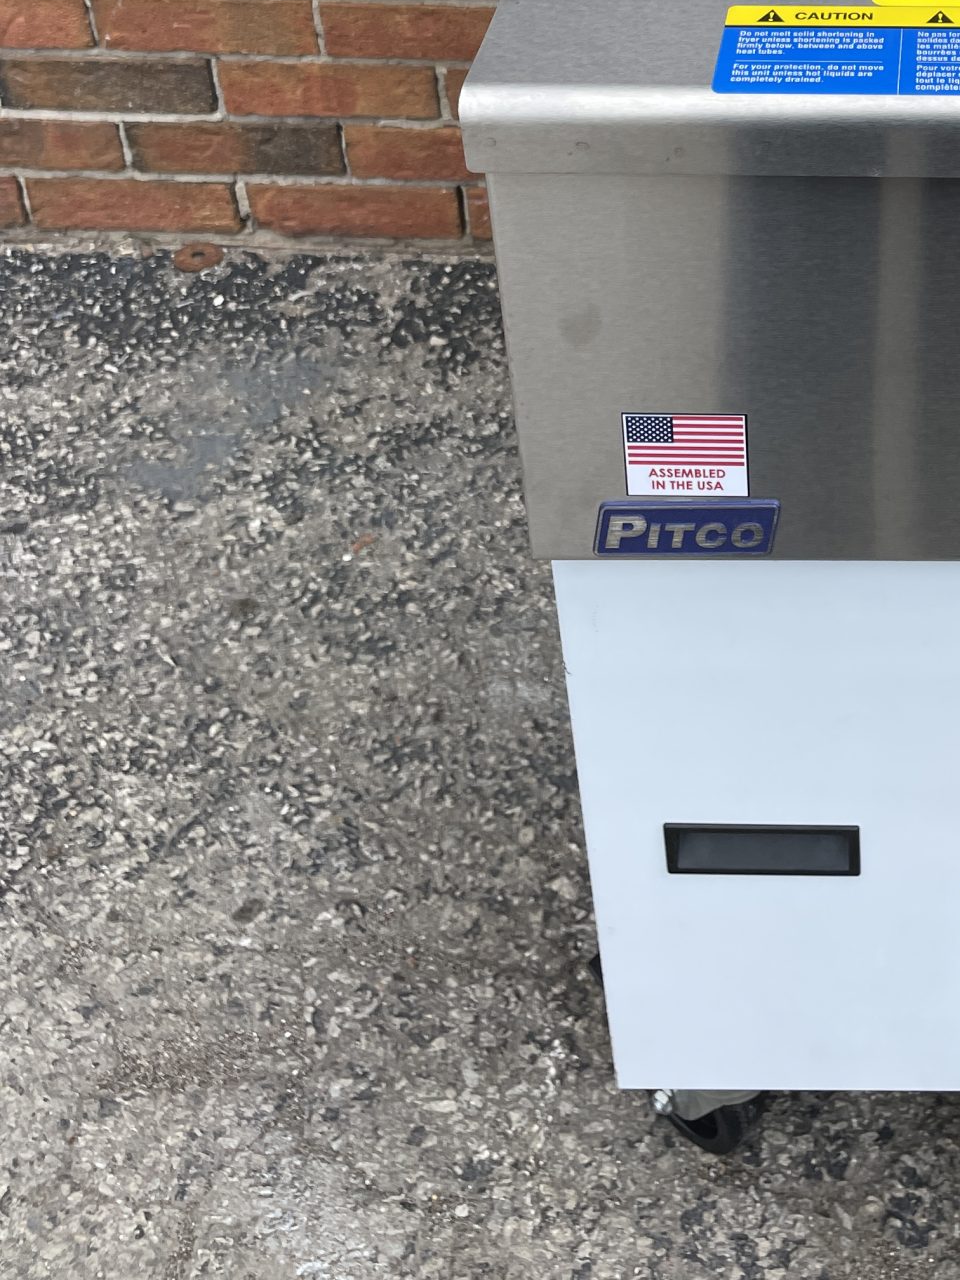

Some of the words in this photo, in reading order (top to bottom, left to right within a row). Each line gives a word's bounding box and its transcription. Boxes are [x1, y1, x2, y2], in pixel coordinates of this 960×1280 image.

[795, 12, 874, 20] CAUTION
[648, 468, 726, 478] ASSEMBLED
[651, 480, 666, 490] IN
[670, 480, 693, 490] THE
[697, 481, 724, 491] USA
[605, 514, 764, 549] PITCO
